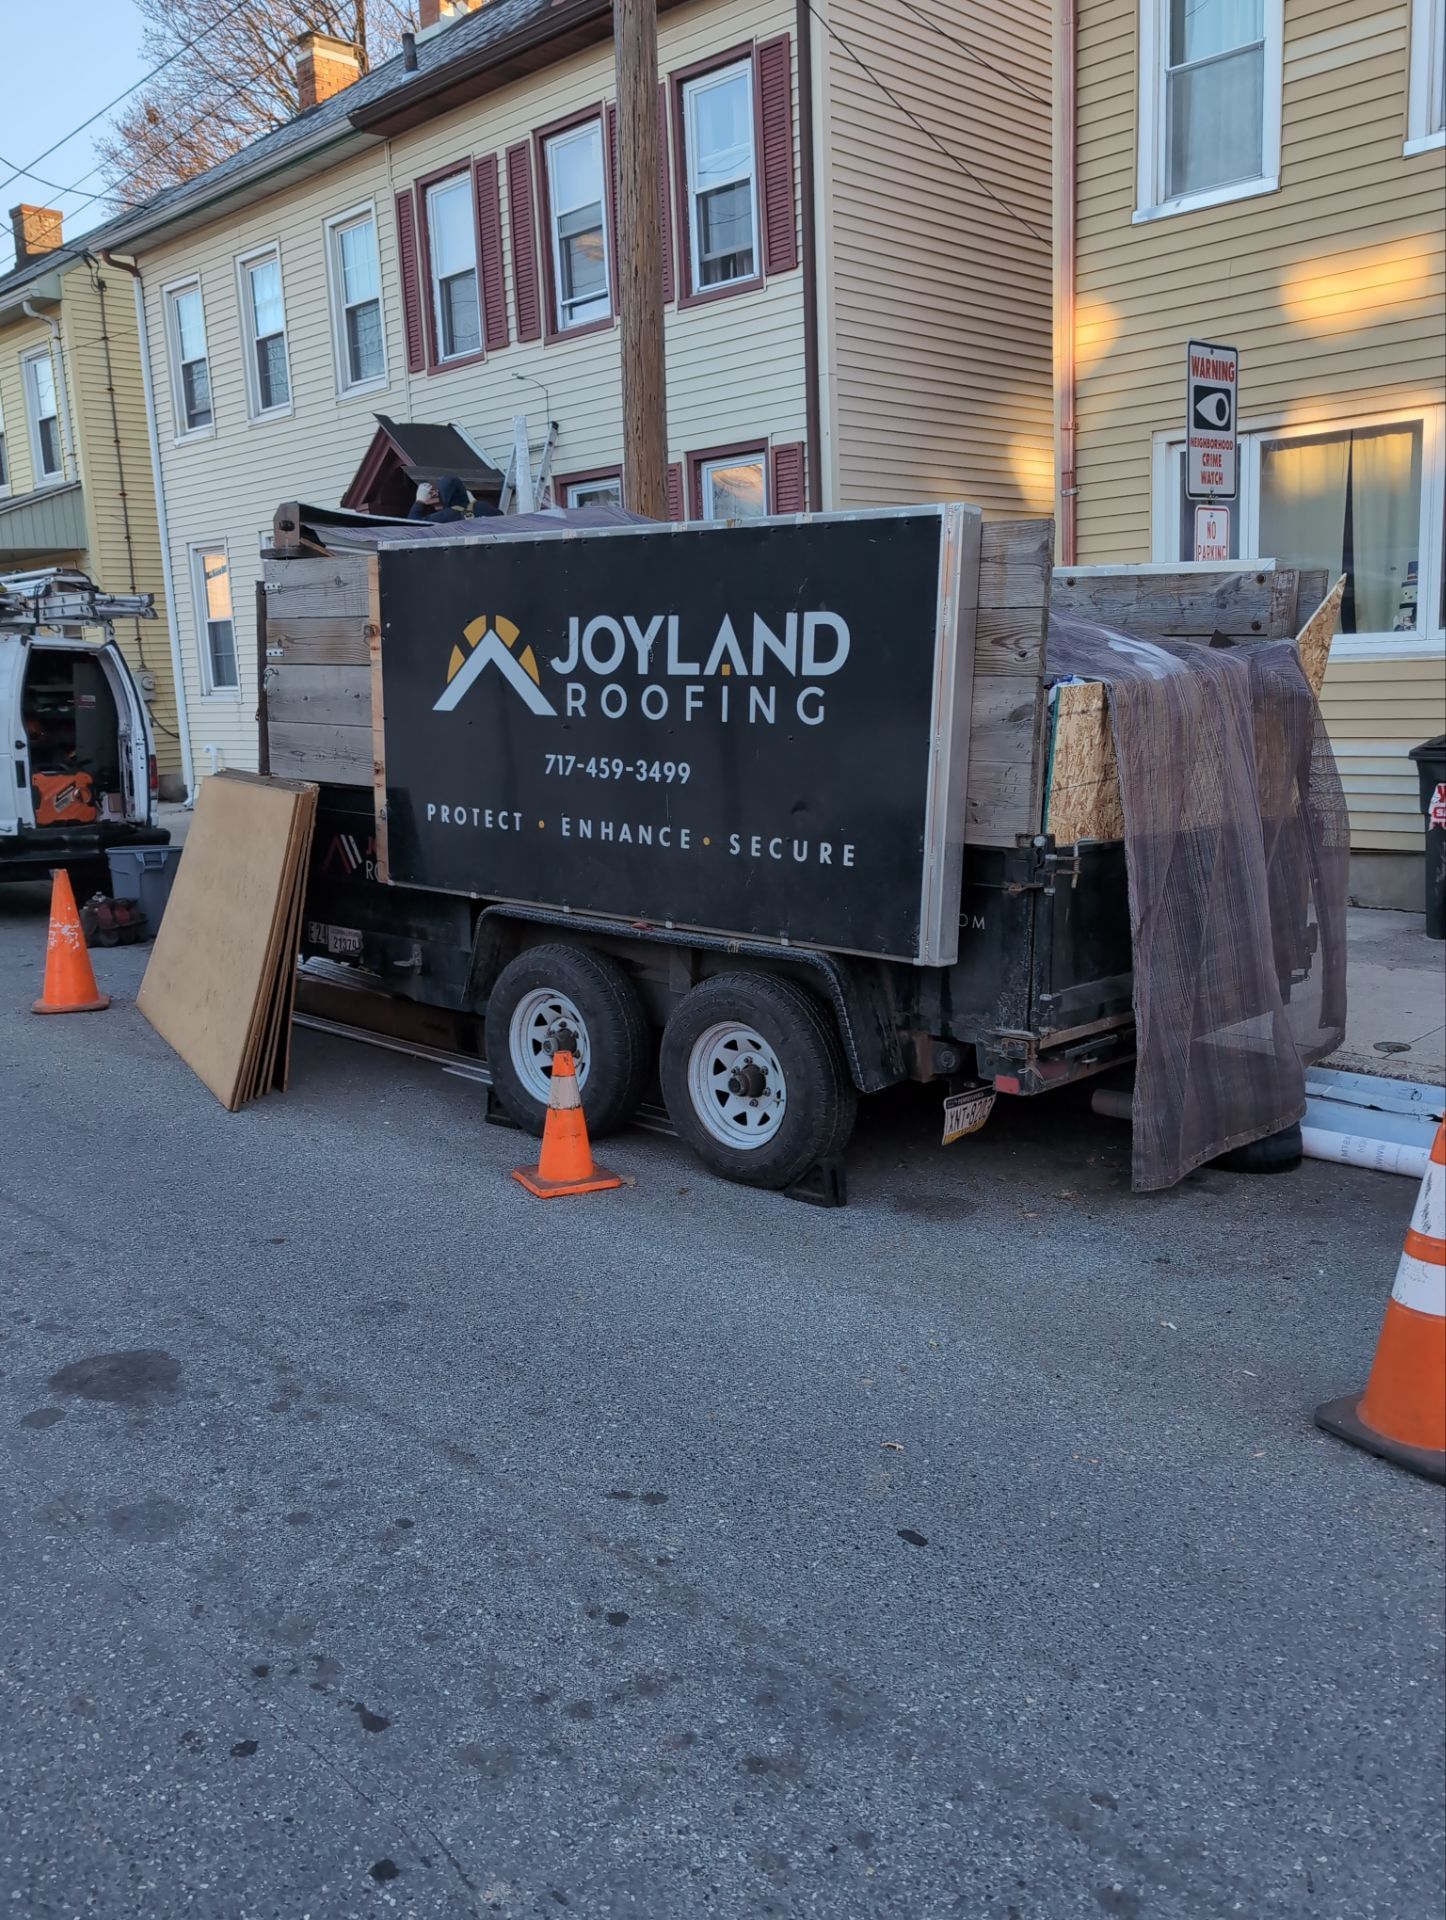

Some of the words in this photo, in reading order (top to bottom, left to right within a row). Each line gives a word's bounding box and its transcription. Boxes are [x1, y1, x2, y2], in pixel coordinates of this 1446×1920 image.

[1191, 355, 1235, 383] WARNING
[1190, 437, 1234, 451] NEIGHBORHOOD
[1202, 453, 1223, 468] CRIME
[1201, 471, 1224, 485] WATCH
[1206, 521, 1217, 540] NO
[1198, 545, 1227, 560] PARKING
[551, 611, 851, 677] JOYLAND
[566, 682, 825, 726] ROOFING
[544, 753, 691, 785] 717-459-3499
[427, 803, 522, 831] PROTECT
[561, 817, 691, 849] ENHANCE
[729, 833, 855, 867] SECURE
